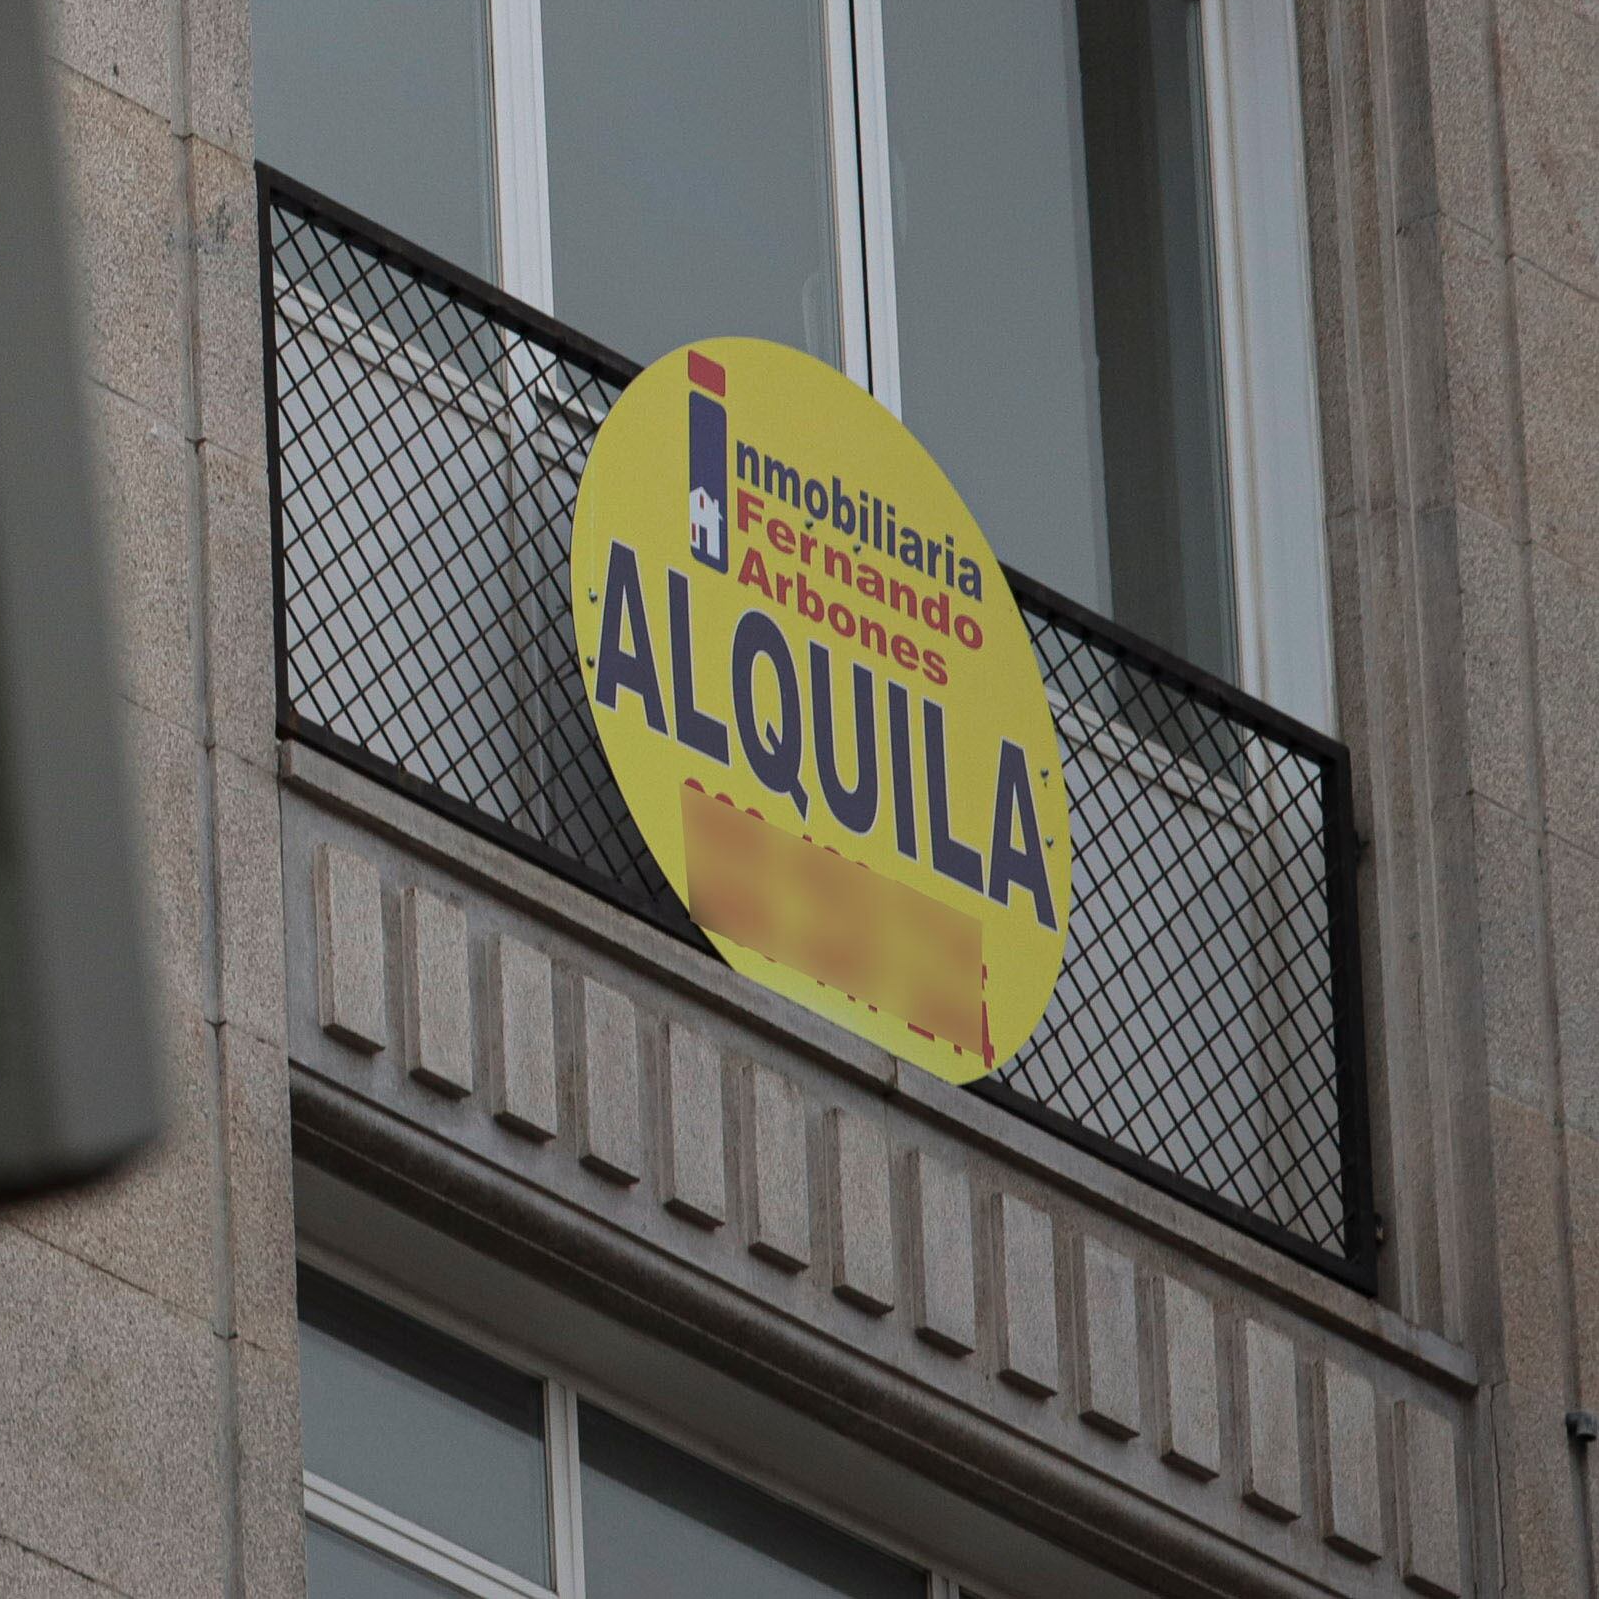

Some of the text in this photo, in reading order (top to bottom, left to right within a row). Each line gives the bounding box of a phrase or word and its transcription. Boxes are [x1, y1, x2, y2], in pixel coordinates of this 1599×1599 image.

[738, 488, 983, 650] Fernando
[738, 549, 948, 686] Arbones
[595, 539, 1057, 933] ALQUILA
